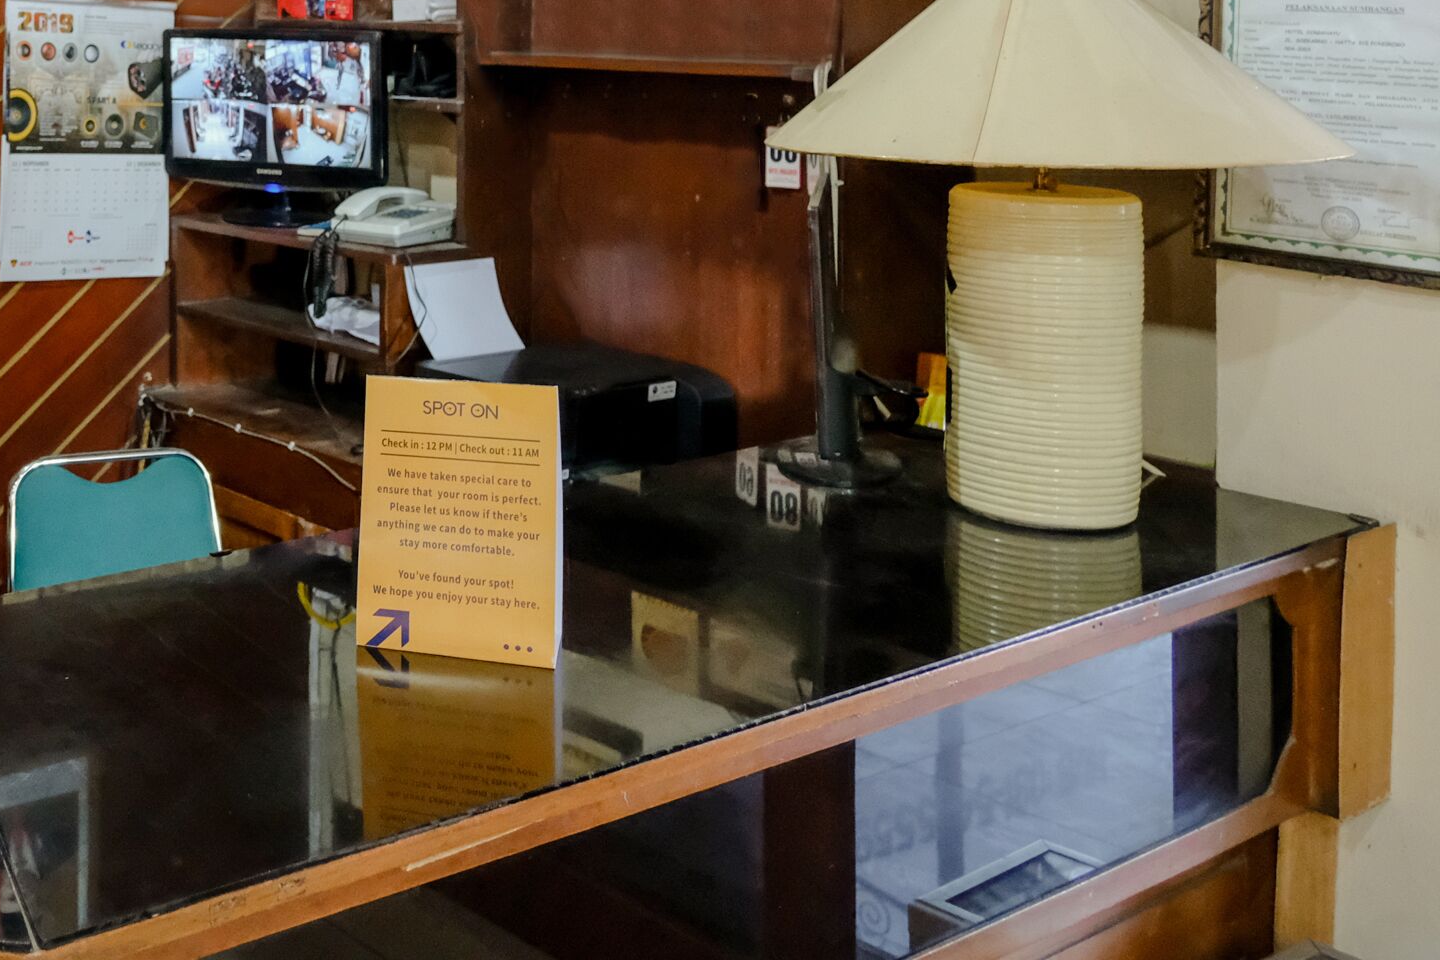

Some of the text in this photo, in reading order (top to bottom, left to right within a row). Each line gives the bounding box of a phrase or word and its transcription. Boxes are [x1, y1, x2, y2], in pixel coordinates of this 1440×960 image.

[17, 11, 74, 33] 2019
[423, 400, 499, 419] SPOT ON
[382, 438, 408, 449] Check
[411, 440, 419, 449] in
[427, 442, 436, 451] 12
[439, 442, 452, 451] PM
[460, 443, 487, 454] Check
[490, 446, 504, 456] out
[513, 447, 522, 456] 11
[525, 448, 539, 458] AM
[388, 468, 532, 488] We have taken special care to
[377, 485, 542, 506] ensure that your room is perfect.
[390, 502, 528, 522] Please let us know if there's
[377, 519, 540, 541] anything we can do to make your
[399, 538, 515, 556] stay more comfortable.
[398, 569, 514, 589] You've found your spot!
[373, 584, 540, 610] We hope you enjoy your stay here.
